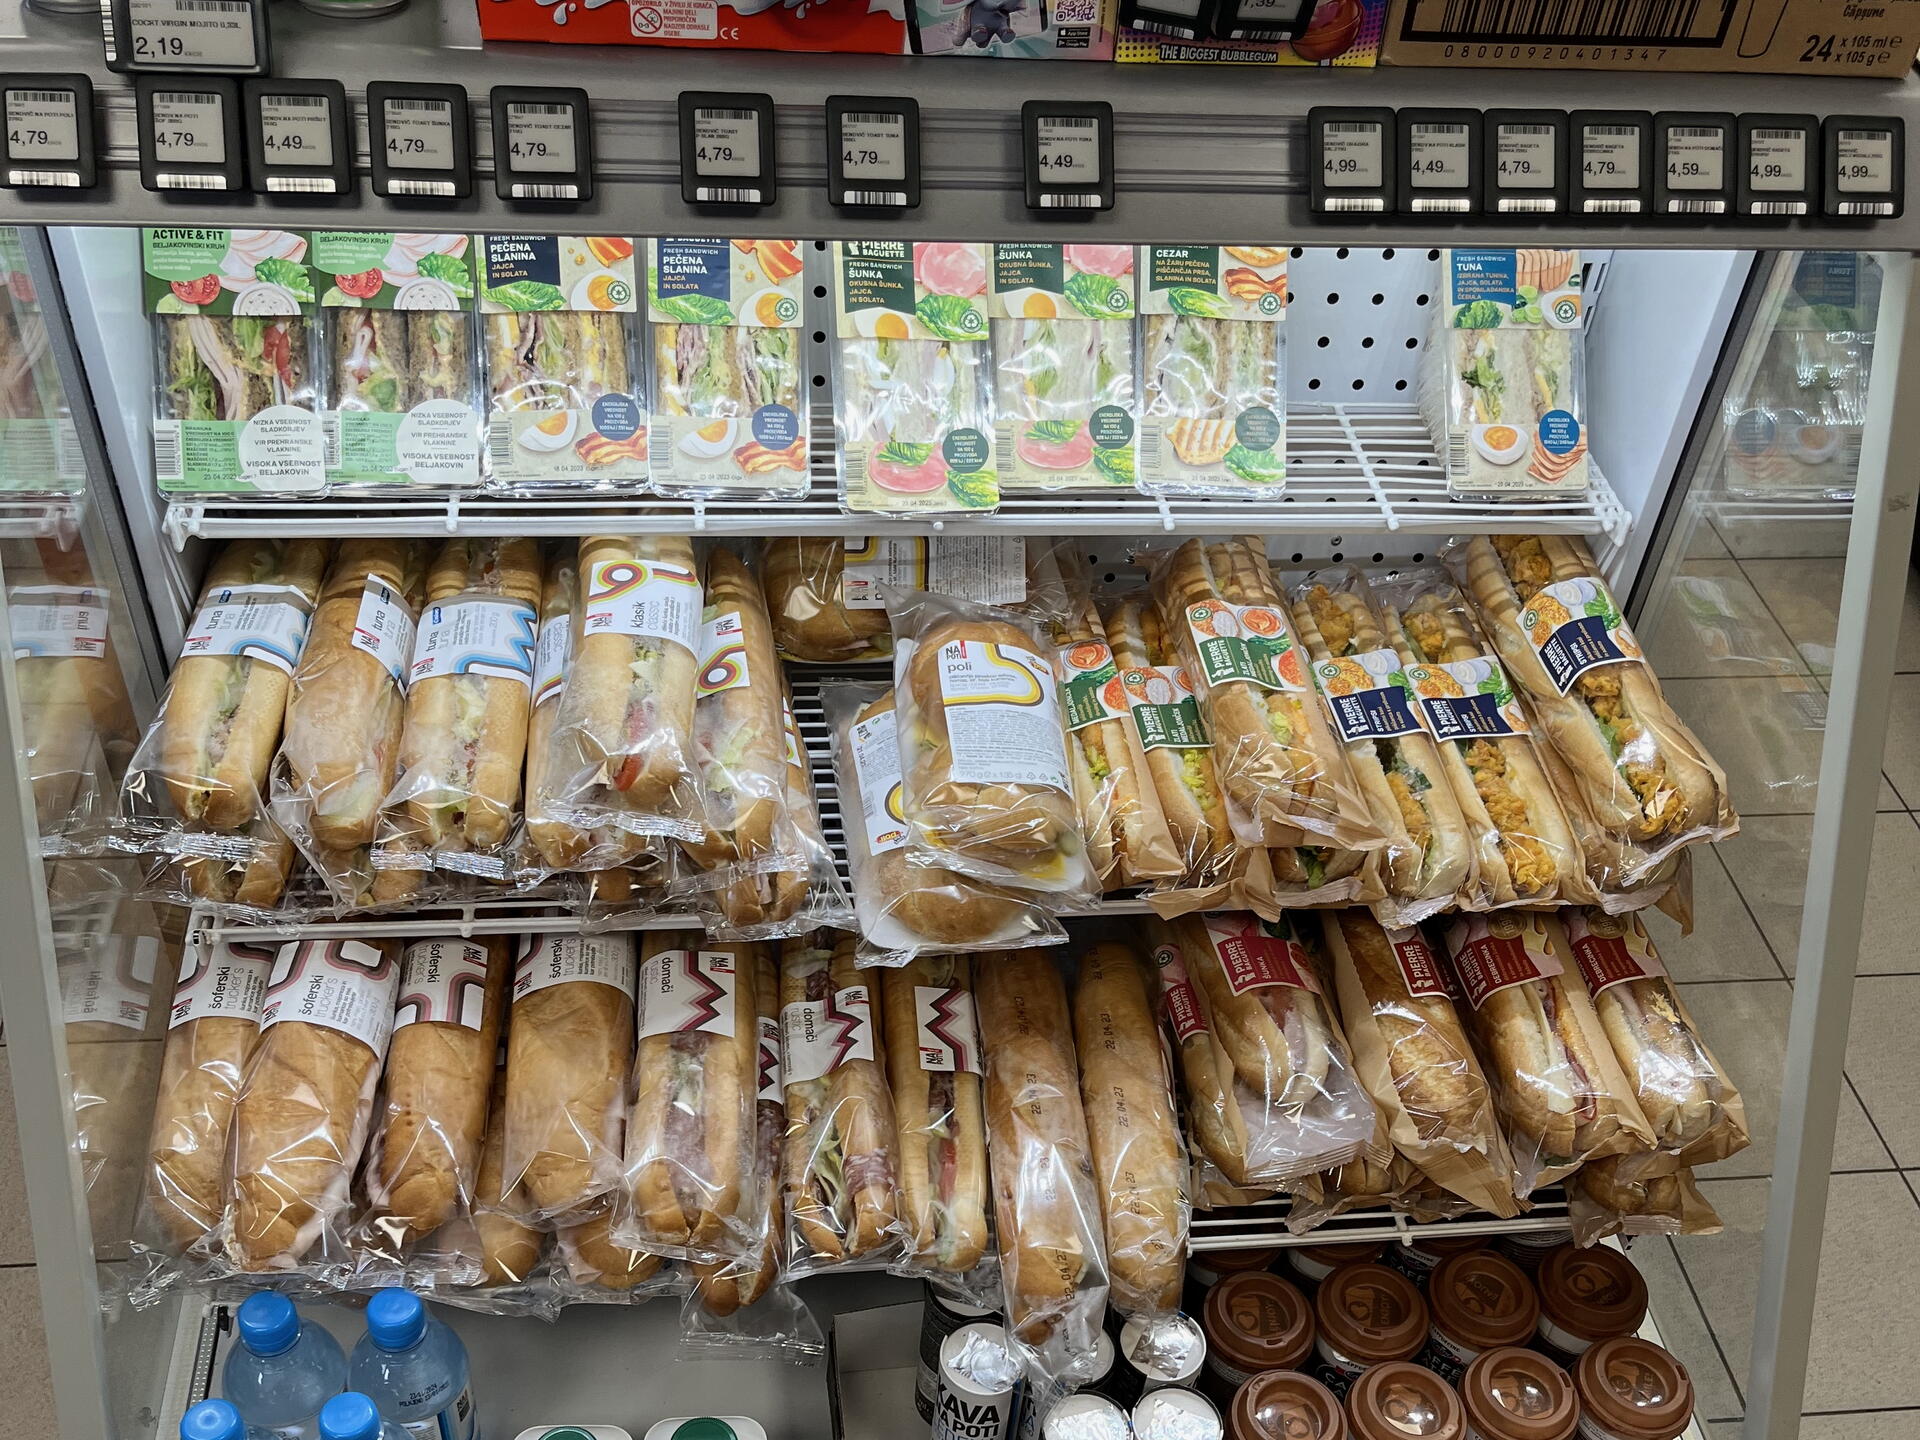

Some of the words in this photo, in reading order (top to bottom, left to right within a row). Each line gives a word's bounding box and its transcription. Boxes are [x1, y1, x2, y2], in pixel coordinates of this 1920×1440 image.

[136, 37, 183, 58] 2,19
[1161, 45, 1179, 59] THE
[1181, 47, 1219, 60] BIGGEST
[1220, 51, 1277, 61] BUBBLEGUM
[1800, 35, 1835, 62] 24
[1840, 39, 1847, 47] x
[1853, 36, 1869, 47] 105
[1873, 36, 1888, 48] ml
[1847, 52, 1864, 62] 105
[1866, 56, 1875, 65] g
[10, 131, 48, 146] 4,79
[157, 132, 194, 147] 4,79
[265, 136, 302, 151] 4,49
[388, 139, 424, 154] 4,79
[511, 143, 547, 159] 4,79
[697, 147, 732, 163] 4,79
[844, 151, 877, 166] 4,79
[1040, 155, 1072, 170] 4,49
[1324, 160, 1357, 174] 4,99
[1412, 161, 1444, 175] 4,49
[1499, 161, 1530, 176] 4,79
[1584, 162, 1615, 176] 4,79
[1669, 163, 1699, 177] 4,59
[1751, 164, 1782, 178] 4,99
[1839, 166, 1868, 178] 4,99
[153, 230, 193, 239] ACTIVE
[196, 230, 205, 239] &
[207, 231, 224, 240] FIT
[320, 236, 369, 244] BELJAKOVINSKI
[371, 237, 389, 245] KRUH
[491, 241, 530, 252] PEČENA
[862, 242, 904, 250] PIERRE
[862, 249, 904, 258] BAGUETTE
[491, 252, 536, 262] SLANINA
[663, 255, 702, 265] PEČENA
[999, 250, 1032, 260] ŠUNKA
[1156, 249, 1188, 259] CEZAR
[492, 263, 514, 271] JAJCA
[663, 265, 707, 274] SLANINA
[1166, 259, 1183, 268] ŽARU
[1185, 260, 1210, 268] PEČENA
[1457, 263, 1482, 271] TUNA
[501, 270, 528, 278] SOLATA
[849, 268, 883, 279] ŠUNKA
[1194, 277, 1216, 285] SOLATA
[849, 288, 872, 296] JAJCA
[858, 296, 884, 304] SOLATA
[205, 610, 223, 630] tuna
[372, 610, 385, 631] tuna
[592, 616, 604, 628] NA
[632, 600, 645, 629] klasik
[648, 601, 660, 630] classic
[721, 619, 734, 631] NA
[189, 640, 202, 650] NA
[360, 634, 372, 646] NA
[426, 630, 439, 653] tuna
[946, 646, 960, 655] NA
[946, 652, 962, 660] POTI
[1208, 640, 1222, 669] PIERRE
[1218, 640, 1233, 669] BAGUETTE
[1550, 638, 1575, 667] BAGUETTE
[1570, 642, 1587, 665] STRIPSI
[948, 662, 972, 673] poli
[1544, 644, 1564, 676] PIERRE
[415, 664, 426, 676] NA
[1339, 698, 1358, 725] PIERRE
[1350, 697, 1366, 726] BAGUETTE
[1431, 700, 1448, 725] PIERRE
[1440, 700, 1458, 726] BAGUETTE
[1141, 706, 1155, 734] PIERRE
[1150, 708, 1163, 734] BAGUETTE
[1172, 708, 1189, 742] MEDALJONČEK
[1374, 710, 1384, 732] STRIPSI
[470, 948, 482, 962] NA
[549, 938, 563, 979] šoferski
[717, 957, 728, 967] NA
[1228, 940, 1244, 973] PIERRE
[1236, 940, 1251, 976] BAGUETTE
[1403, 945, 1422, 978] PIERRE
[1412, 944, 1431, 977] BAGUETTE
[426, 943, 444, 983] šoferski
[1256, 956, 1271, 979] ŠUNKA
[1461, 953, 1478, 987] PIERRE
[1467, 948, 1484, 980] BAGUETTE
[1480, 944, 1501, 984] DEBRECINKA
[1582, 944, 1607, 982] DEBRECINKA
[661, 957, 674, 994] domači
[208, 966, 231, 1009] šoferski
[516, 980, 526, 994] NA
[299, 975, 324, 1016] šoferski
[851, 990, 863, 1000] NA
[1170, 988, 1186, 1022] PIERRE
[1179, 987, 1192, 1020] BAGUETTE
[174, 1006, 186, 1020] NA
[264, 1010, 274, 1024] NA
[803, 1007, 818, 1043] domači
[926, 1052, 937, 1064] NA
[936, 1052, 944, 1064] POTI
[1115, 1086, 1129, 1127] 22.04.23
[953, 1420, 999, 1437] POTI
